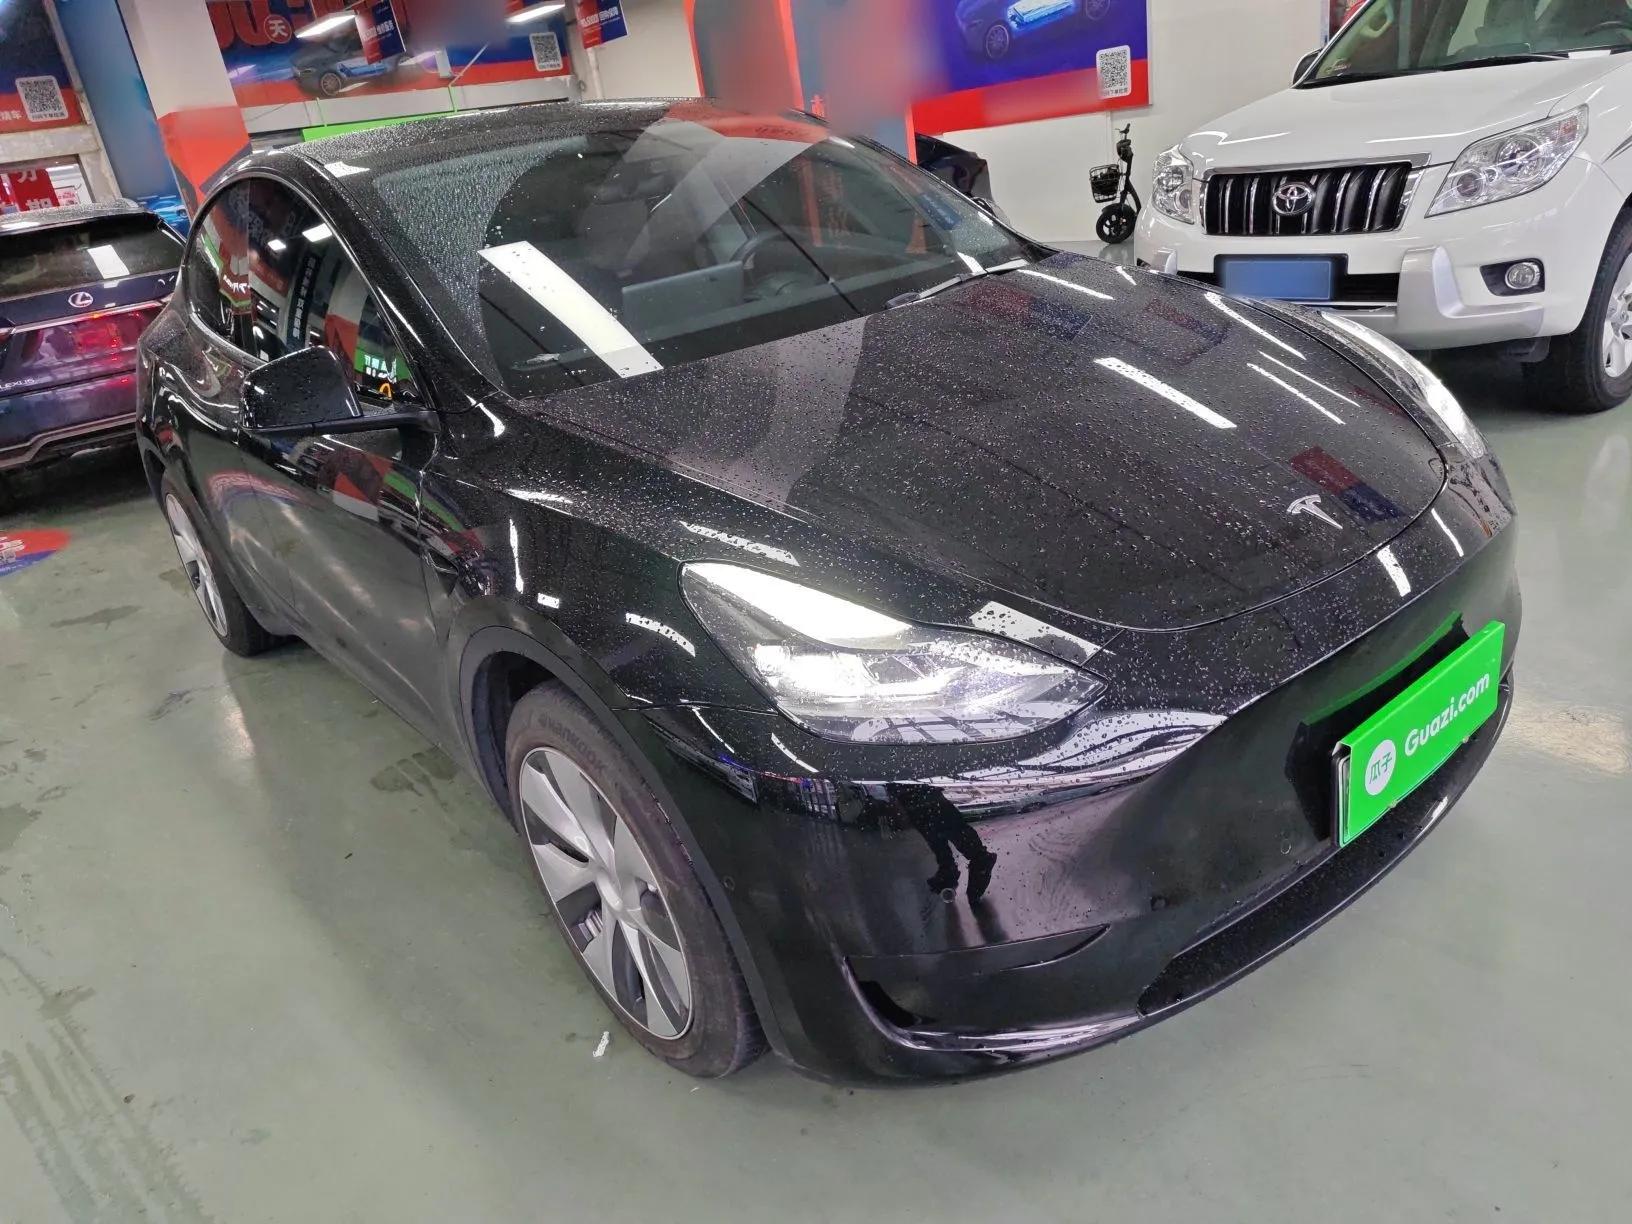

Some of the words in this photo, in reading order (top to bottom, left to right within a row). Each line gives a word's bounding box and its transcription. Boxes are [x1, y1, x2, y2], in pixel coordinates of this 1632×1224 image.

[266, 19, 288, 38] 天
[1368, 751, 1393, 785] 瓜子
[1404, 672, 1490, 757] Guazi.com
